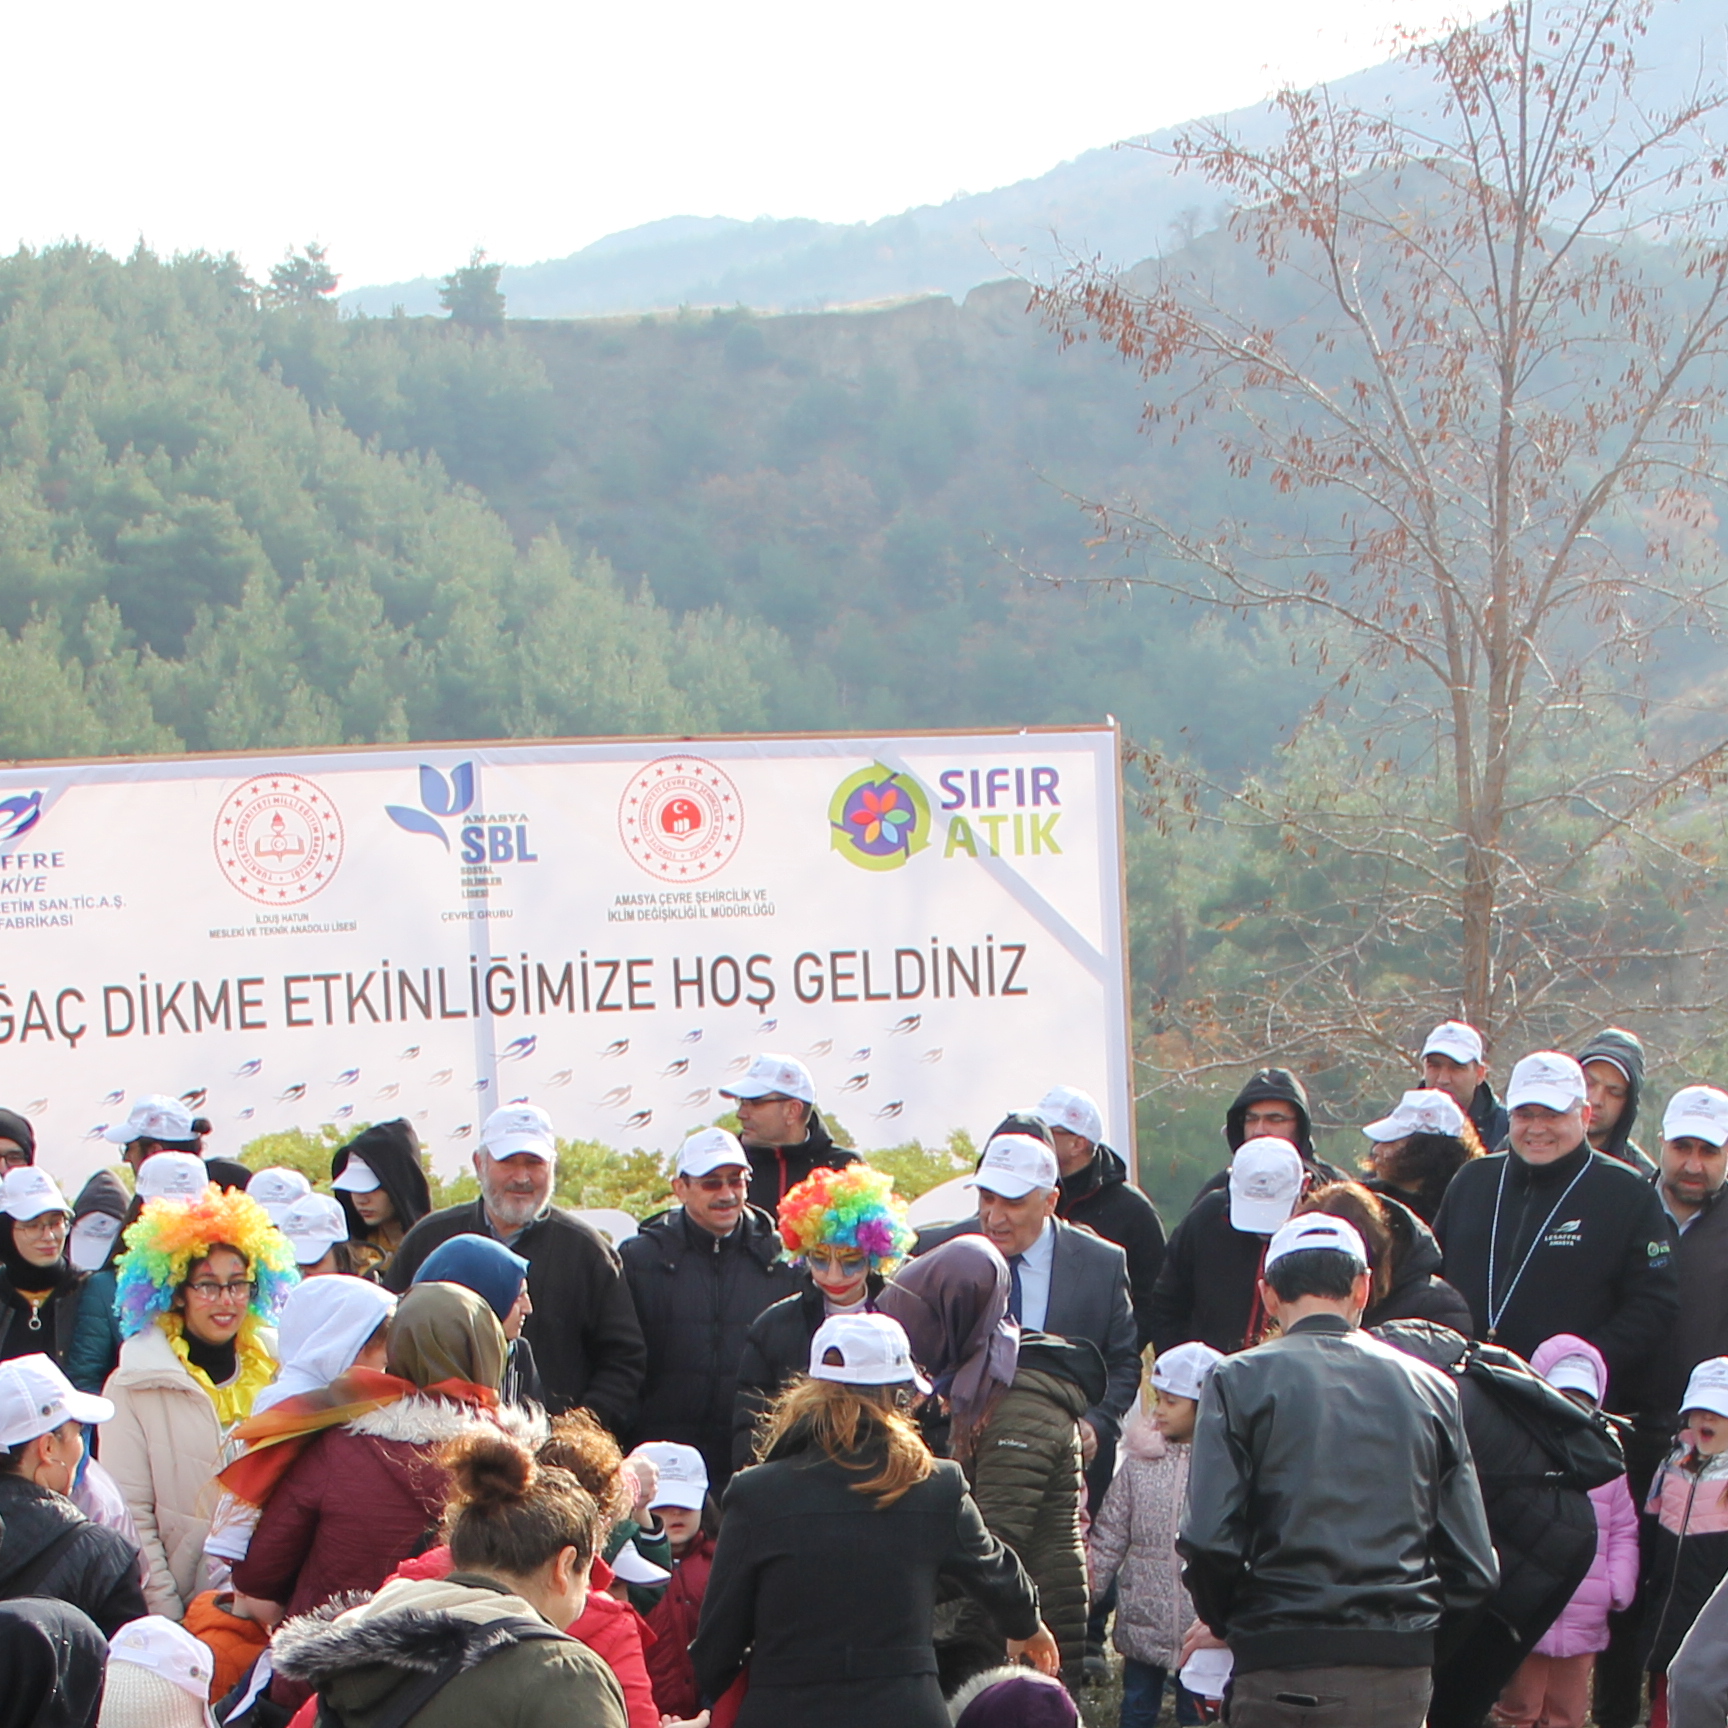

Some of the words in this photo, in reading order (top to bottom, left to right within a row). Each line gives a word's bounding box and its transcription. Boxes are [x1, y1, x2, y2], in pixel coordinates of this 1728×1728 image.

[939, 766, 1062, 812] SIFIR
[462, 813, 530, 824] AMASYA
[460, 825, 538, 864] SBL
[943, 812, 1064, 859] ATIK
[615, 893, 657, 906] AMASYA
[659, 892, 692, 907] ÇEVRE
[695, 887, 751, 905] ŞEHİRCİLİK
[754, 888, 767, 901] VE
[281, 911, 309, 923] HATUN
[441, 911, 475, 923] ÇEVRE
[477, 909, 513, 920] GRUBU
[607, 906, 634, 923] İKLİM
[290, 923, 329, 935] ANADOLU
[104, 972, 267, 1038] DİKME
[284, 949, 655, 1028] ETKİNLİĞİMİZE
[673, 953, 775, 1014] HOŞ
[793, 933, 1029, 1004] GELDİNİZ
